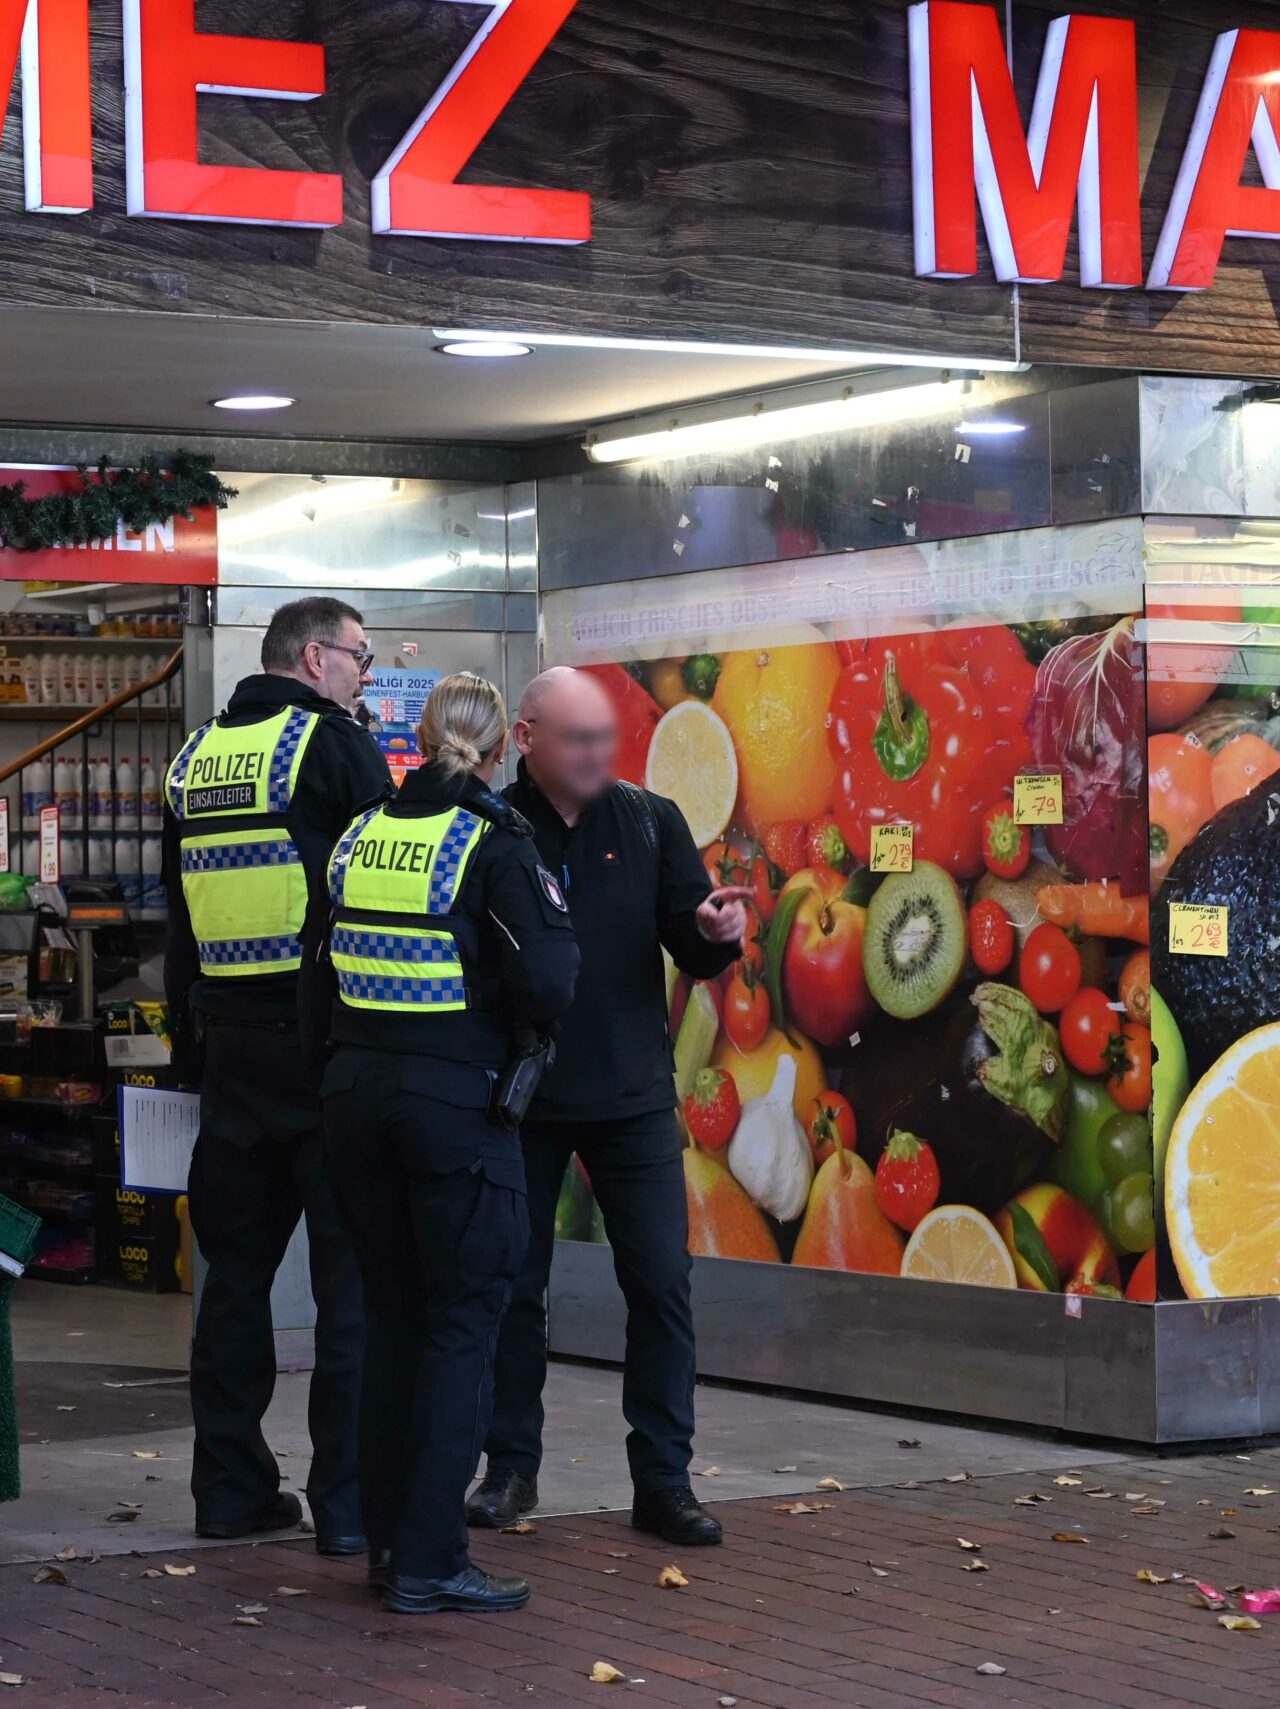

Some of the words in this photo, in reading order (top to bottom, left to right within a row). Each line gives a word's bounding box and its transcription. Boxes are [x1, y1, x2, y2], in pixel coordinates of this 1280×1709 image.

[407, 678, 435, 689] 2025
[190, 752, 265, 786] POLIZEI
[189, 786, 252, 810] EINSATZLEITER
[348, 839, 435, 874] POLIZEI
[124, 1073, 156, 1088] LOCO
[120, 1245, 149, 1262] LOCO
